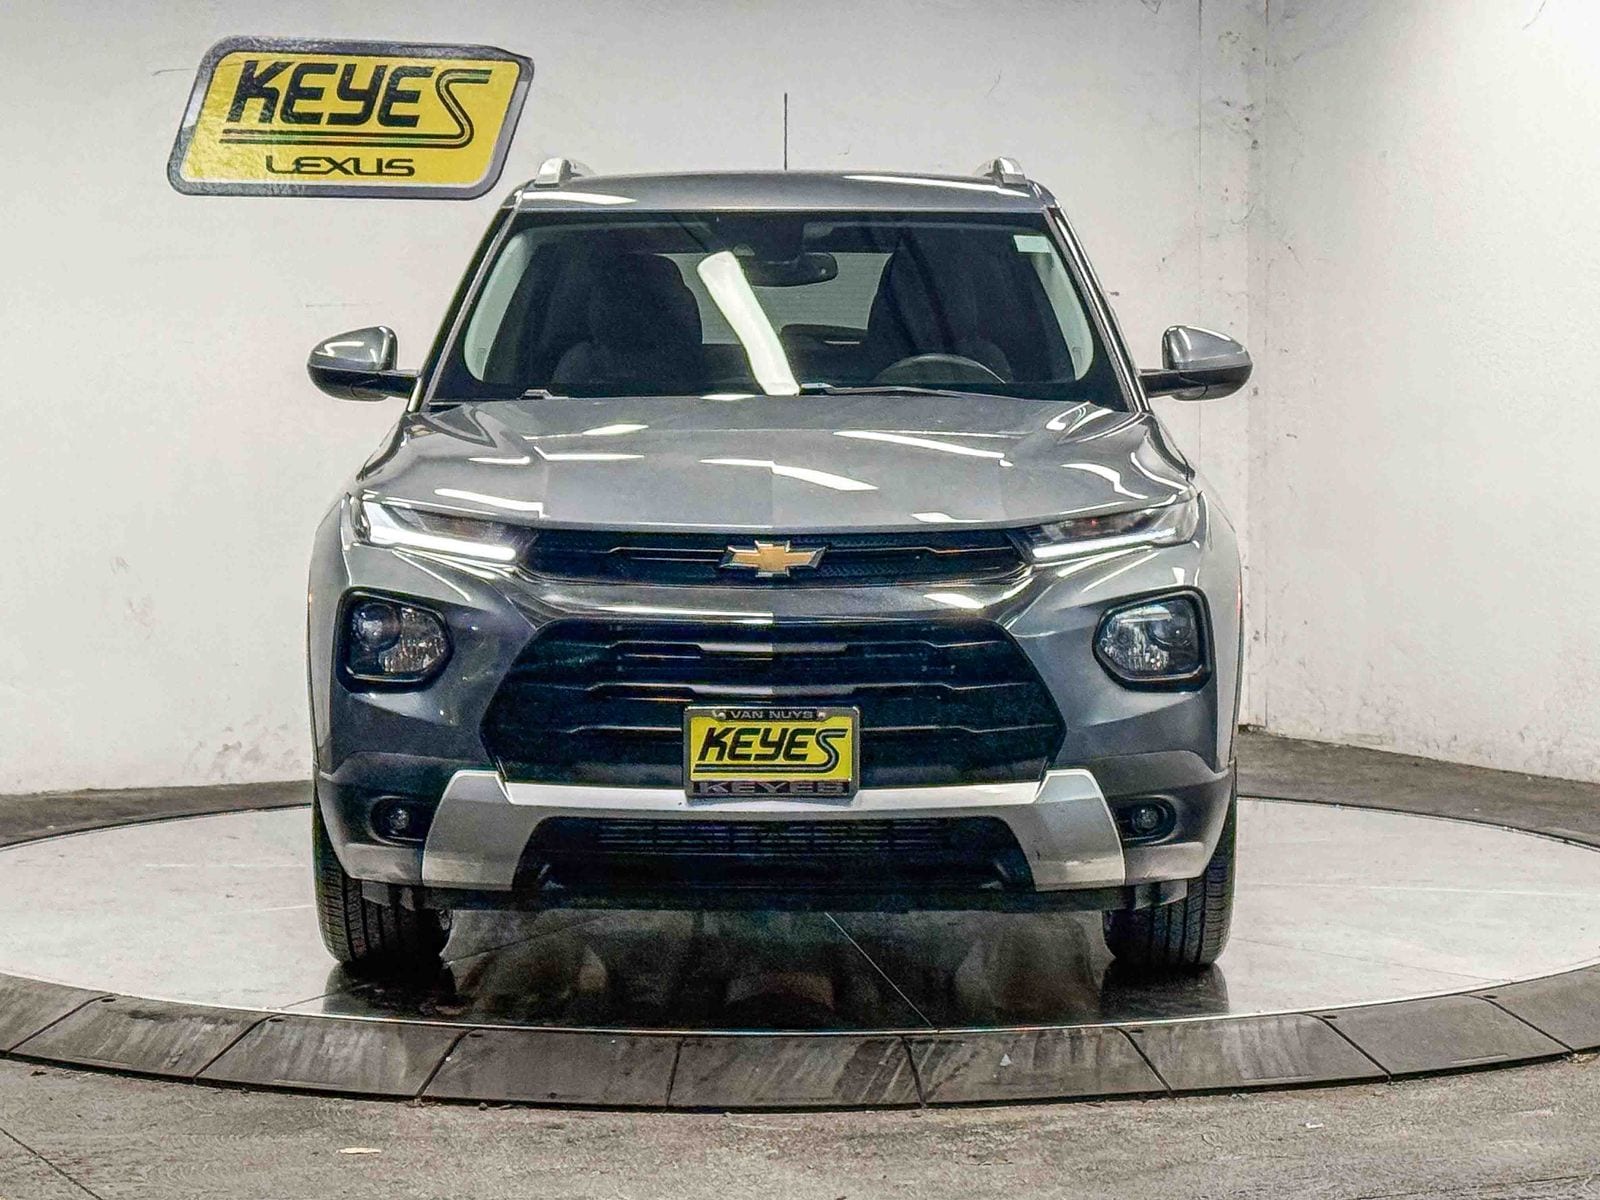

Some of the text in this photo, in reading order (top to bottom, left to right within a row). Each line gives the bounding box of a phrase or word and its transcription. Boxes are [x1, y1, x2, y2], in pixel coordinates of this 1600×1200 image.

[224, 59, 493, 149] KEYES
[265, 154, 416, 177] LEXUS
[730, 710, 814, 719] VAN NUYS
[695, 726, 849, 774] KEYES
[705, 782, 845, 793] KEYES
